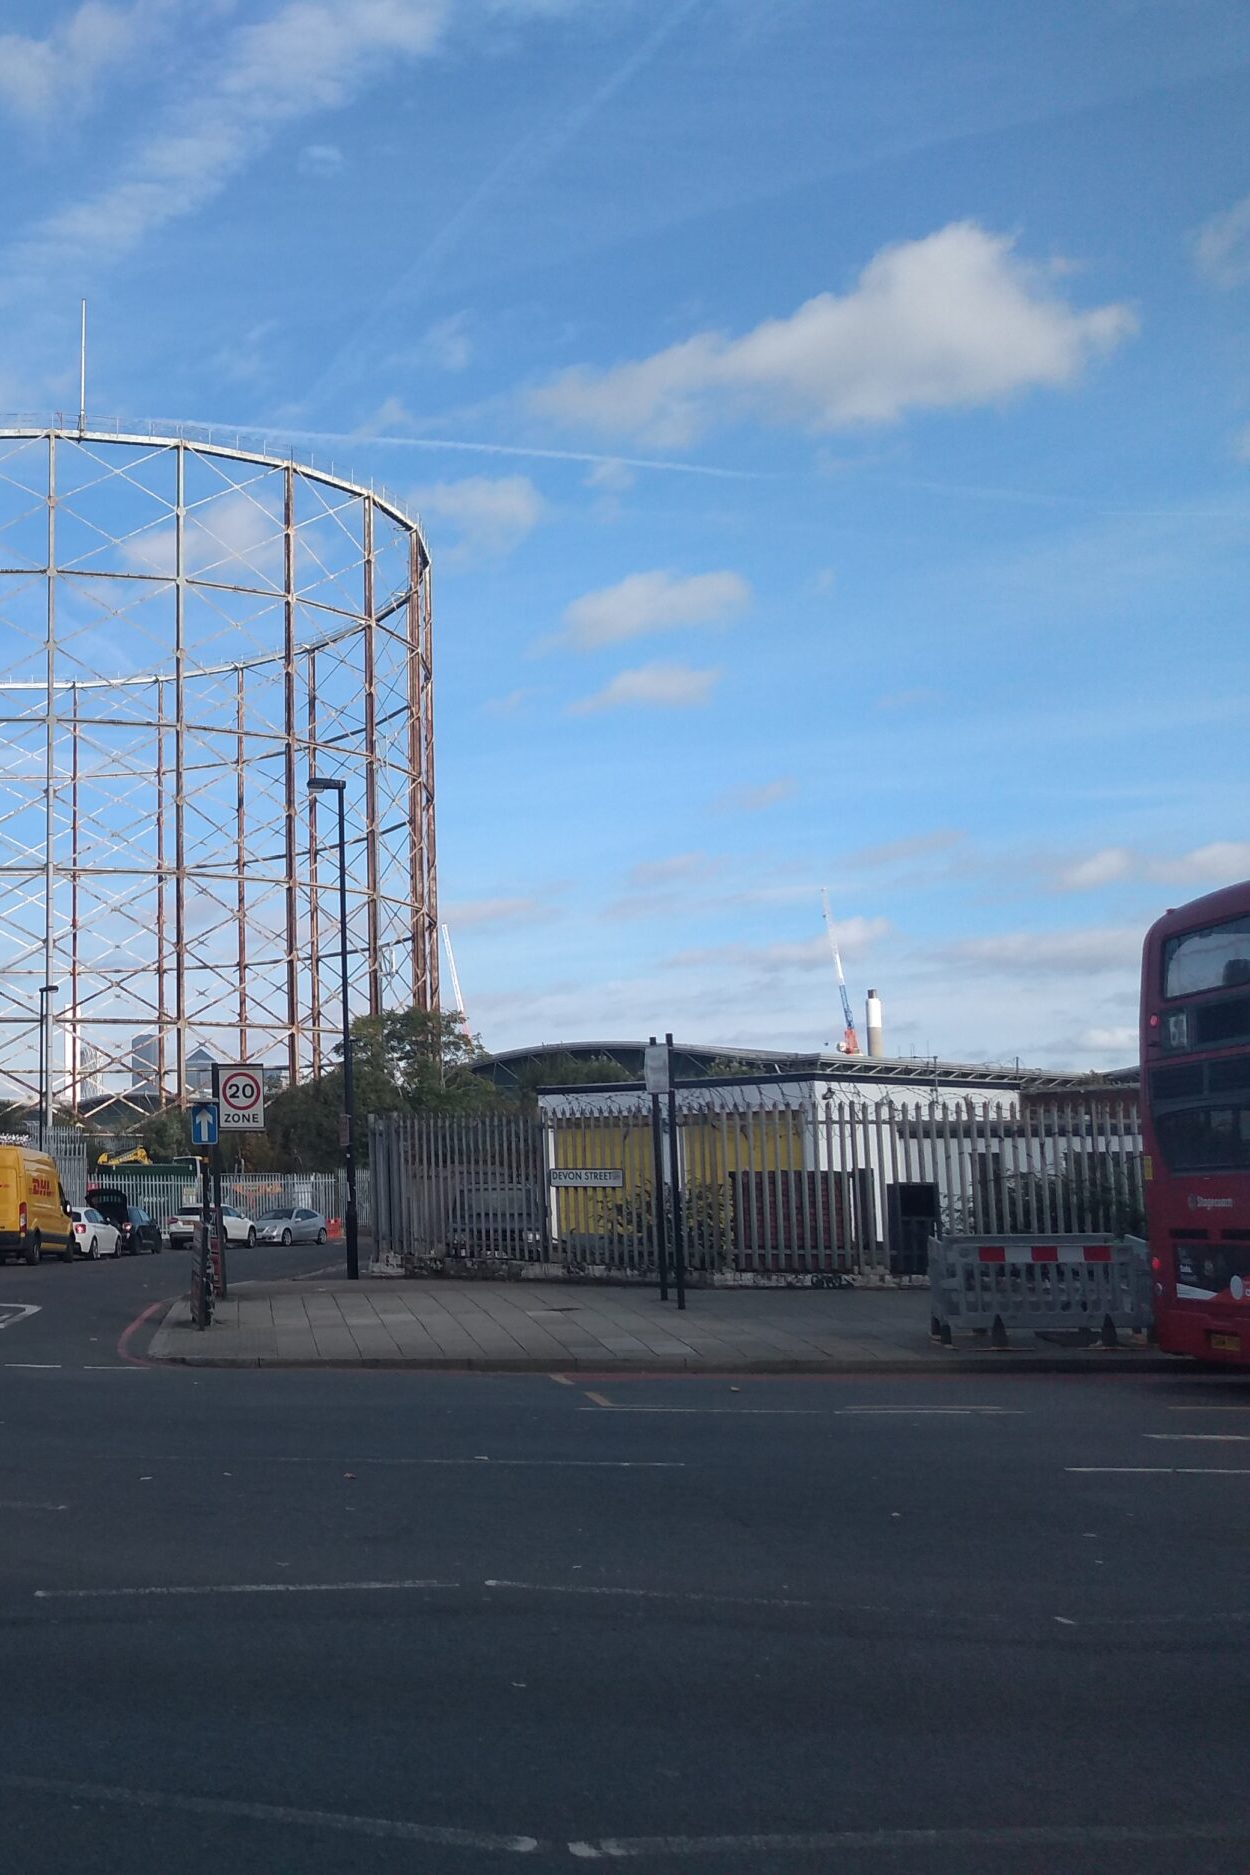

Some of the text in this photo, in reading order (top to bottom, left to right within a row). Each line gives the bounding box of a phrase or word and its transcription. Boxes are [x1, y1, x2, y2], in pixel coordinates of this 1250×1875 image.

[228, 1083, 255, 1099] 20
[224, 1113, 259, 1123] ZONE
[552, 1171, 582, 1180] DEVON
[584, 1171, 612, 1180] STREET
[32, 1178, 52, 1197] DHL
